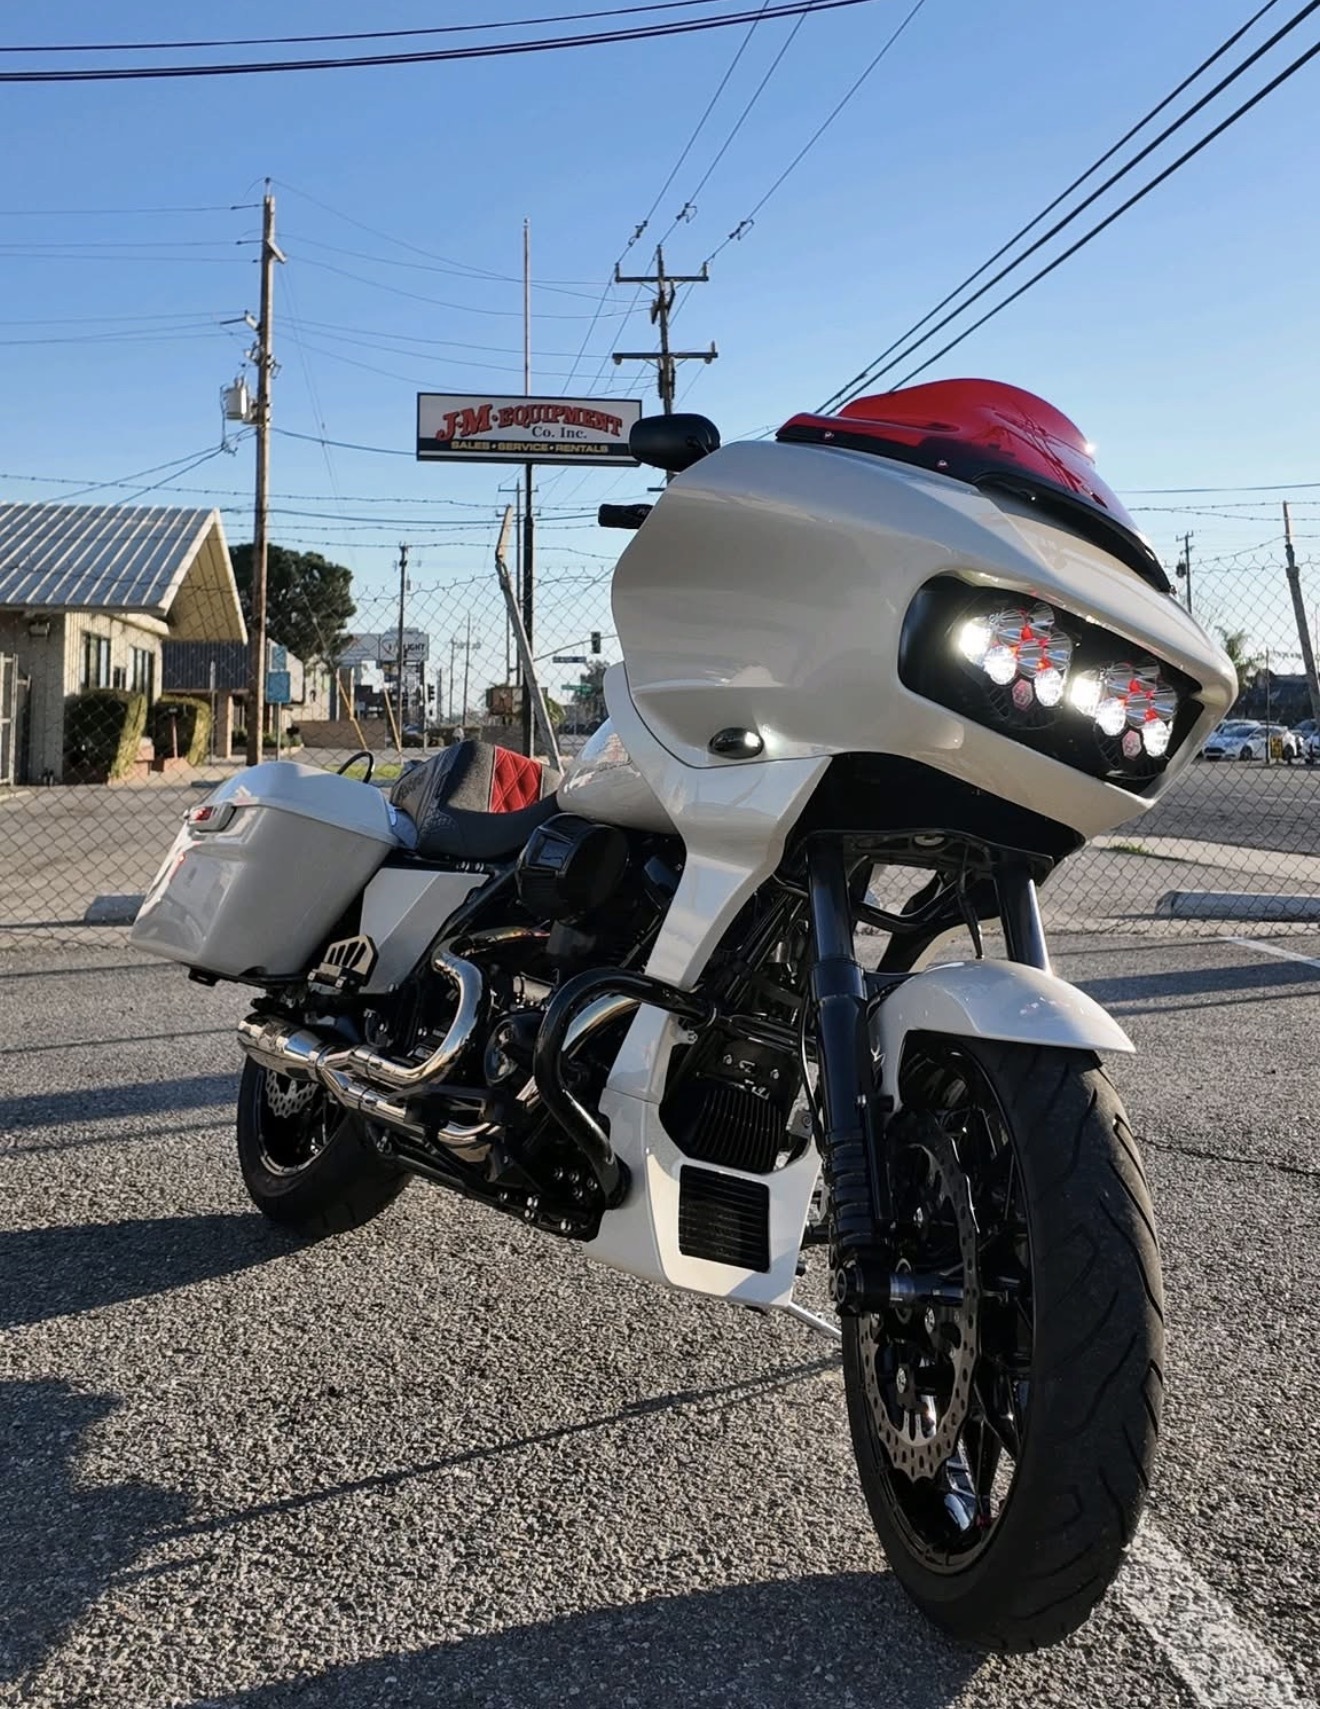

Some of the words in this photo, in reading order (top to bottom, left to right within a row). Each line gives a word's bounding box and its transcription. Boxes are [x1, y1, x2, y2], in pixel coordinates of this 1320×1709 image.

[532, 425, 555, 438] Co.
[560, 427, 587, 439] Inc.
[451, 441, 490, 450] SALES
[498, 442, 548, 452] SERVICE
[555, 444, 609, 453] RENTALS
